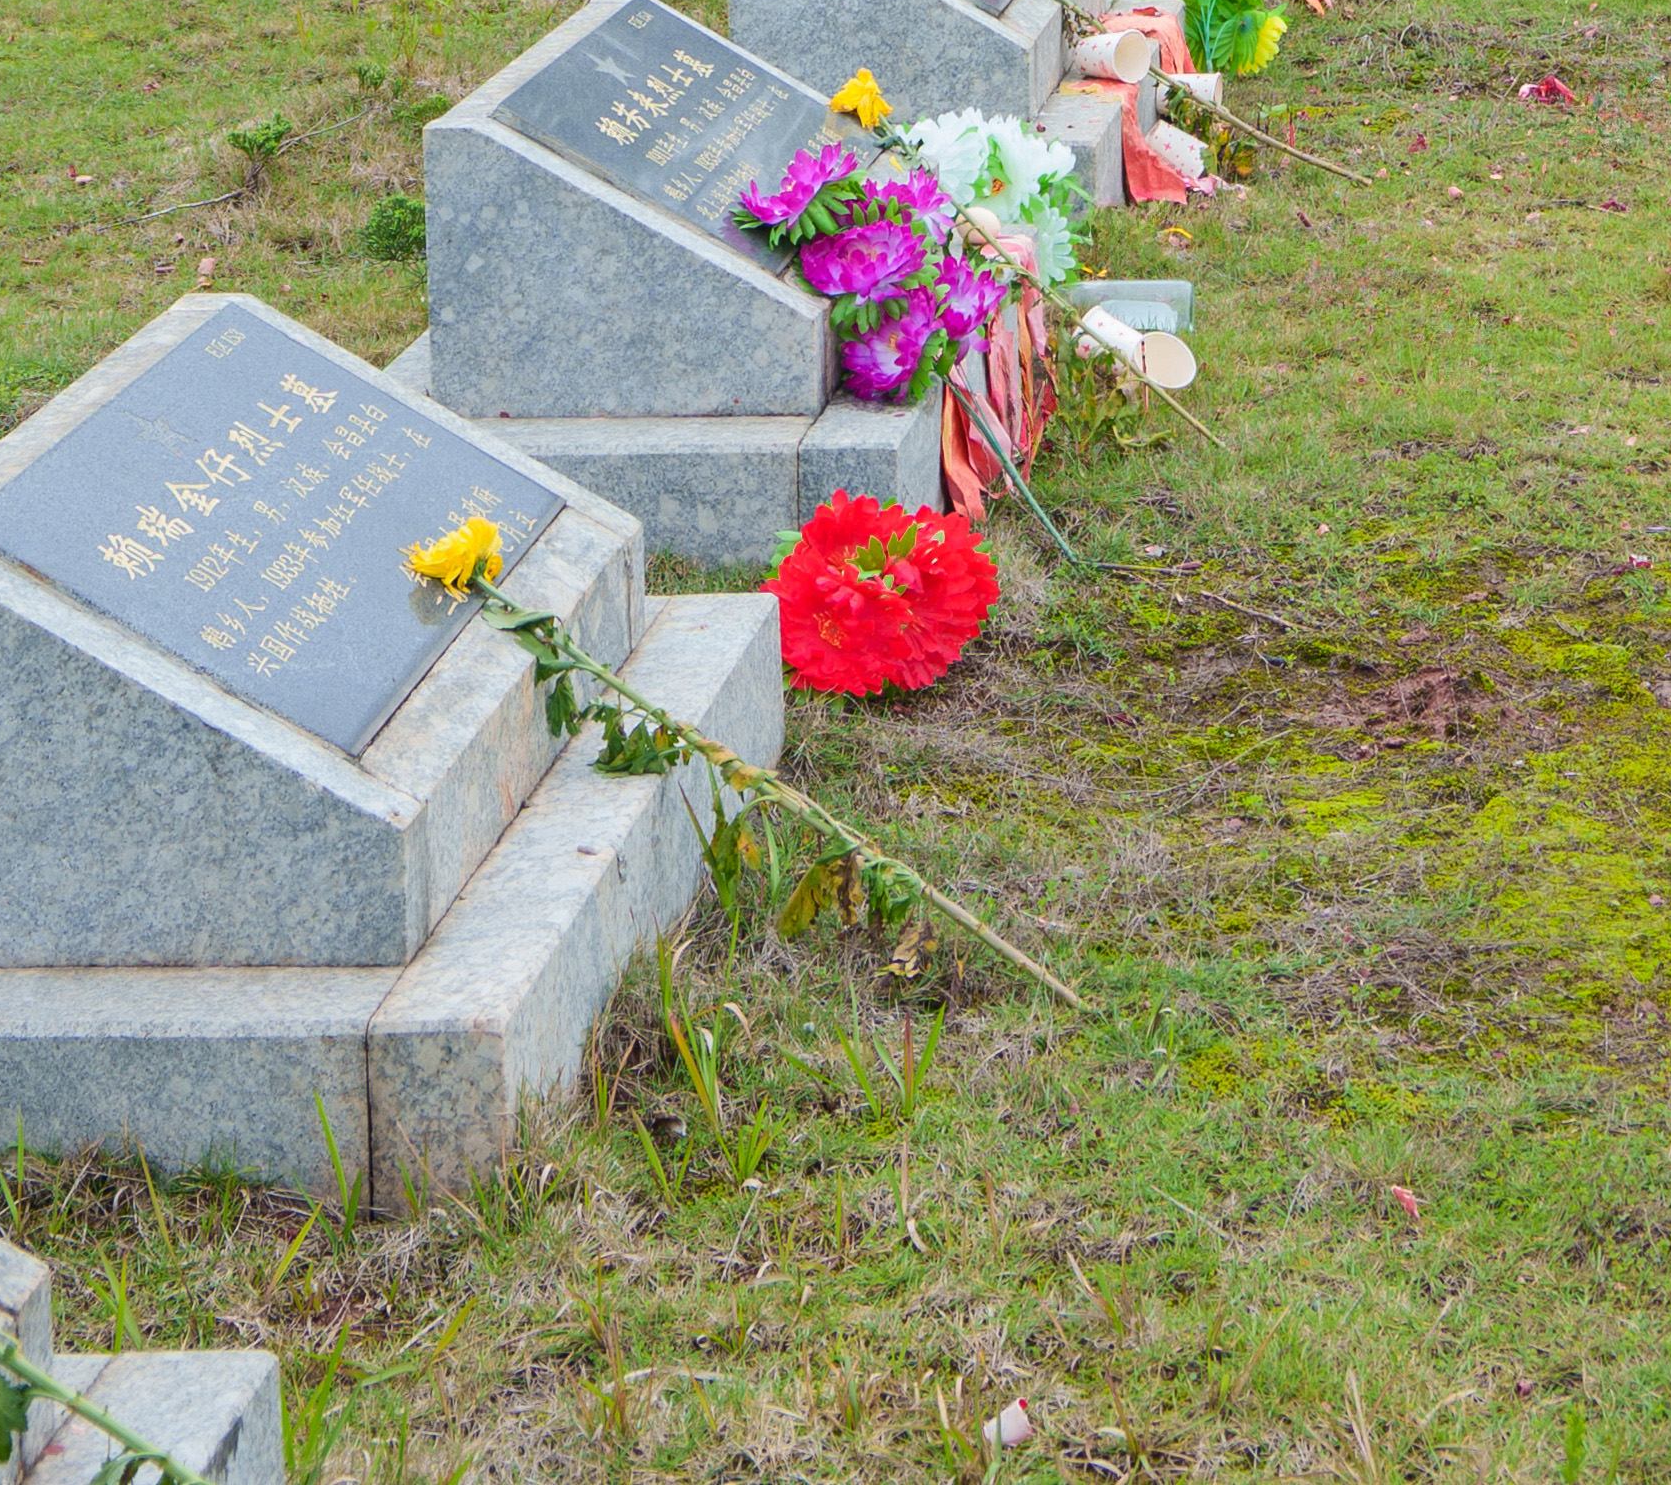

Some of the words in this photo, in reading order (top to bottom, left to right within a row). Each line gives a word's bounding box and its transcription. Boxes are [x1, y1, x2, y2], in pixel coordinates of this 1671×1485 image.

[99, 373, 337, 579] 赖瑞金仔烈士墓
